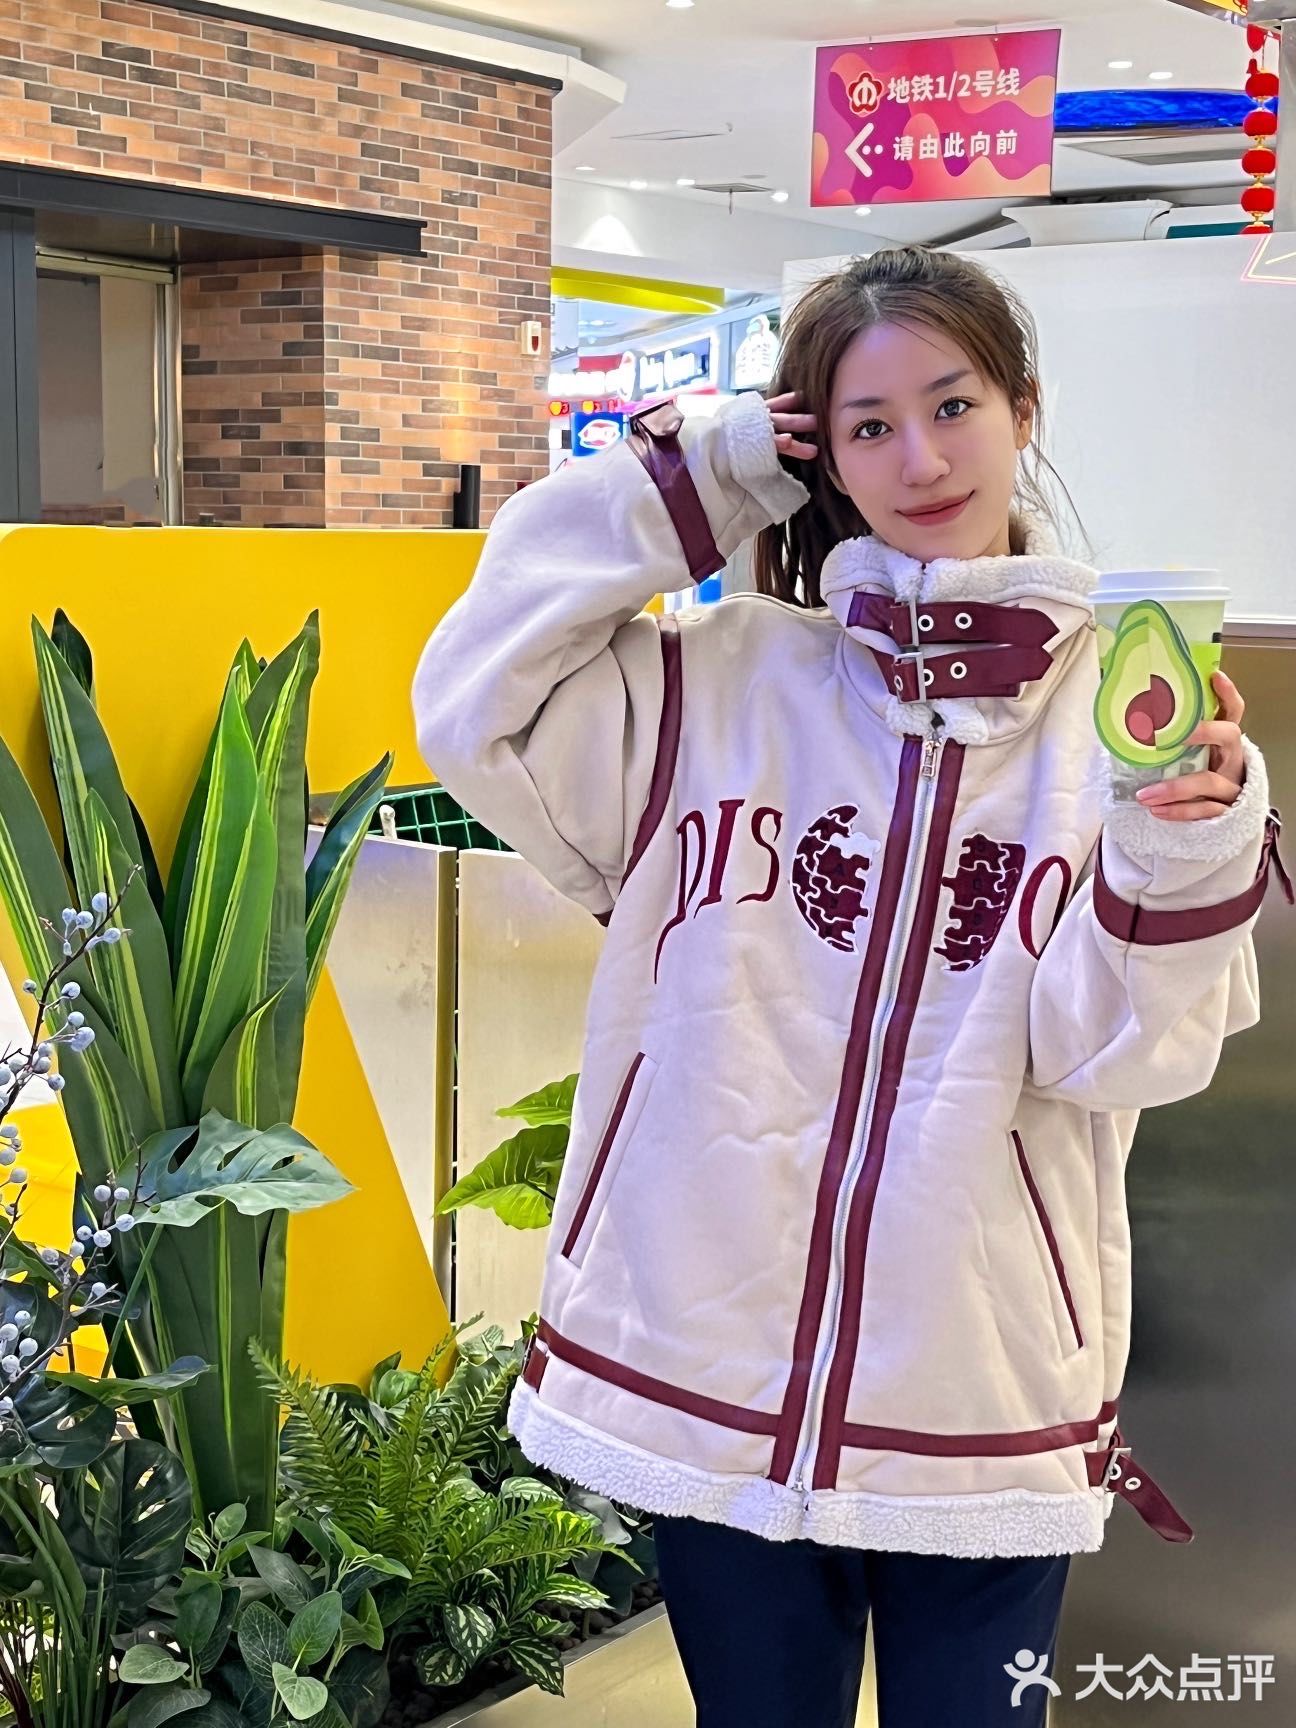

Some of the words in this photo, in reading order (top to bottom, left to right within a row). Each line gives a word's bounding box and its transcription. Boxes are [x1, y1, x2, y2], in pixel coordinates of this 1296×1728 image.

[886, 67, 1022, 105] 地铁1/2号线
[892, 128, 1018, 161] 请由此向前
